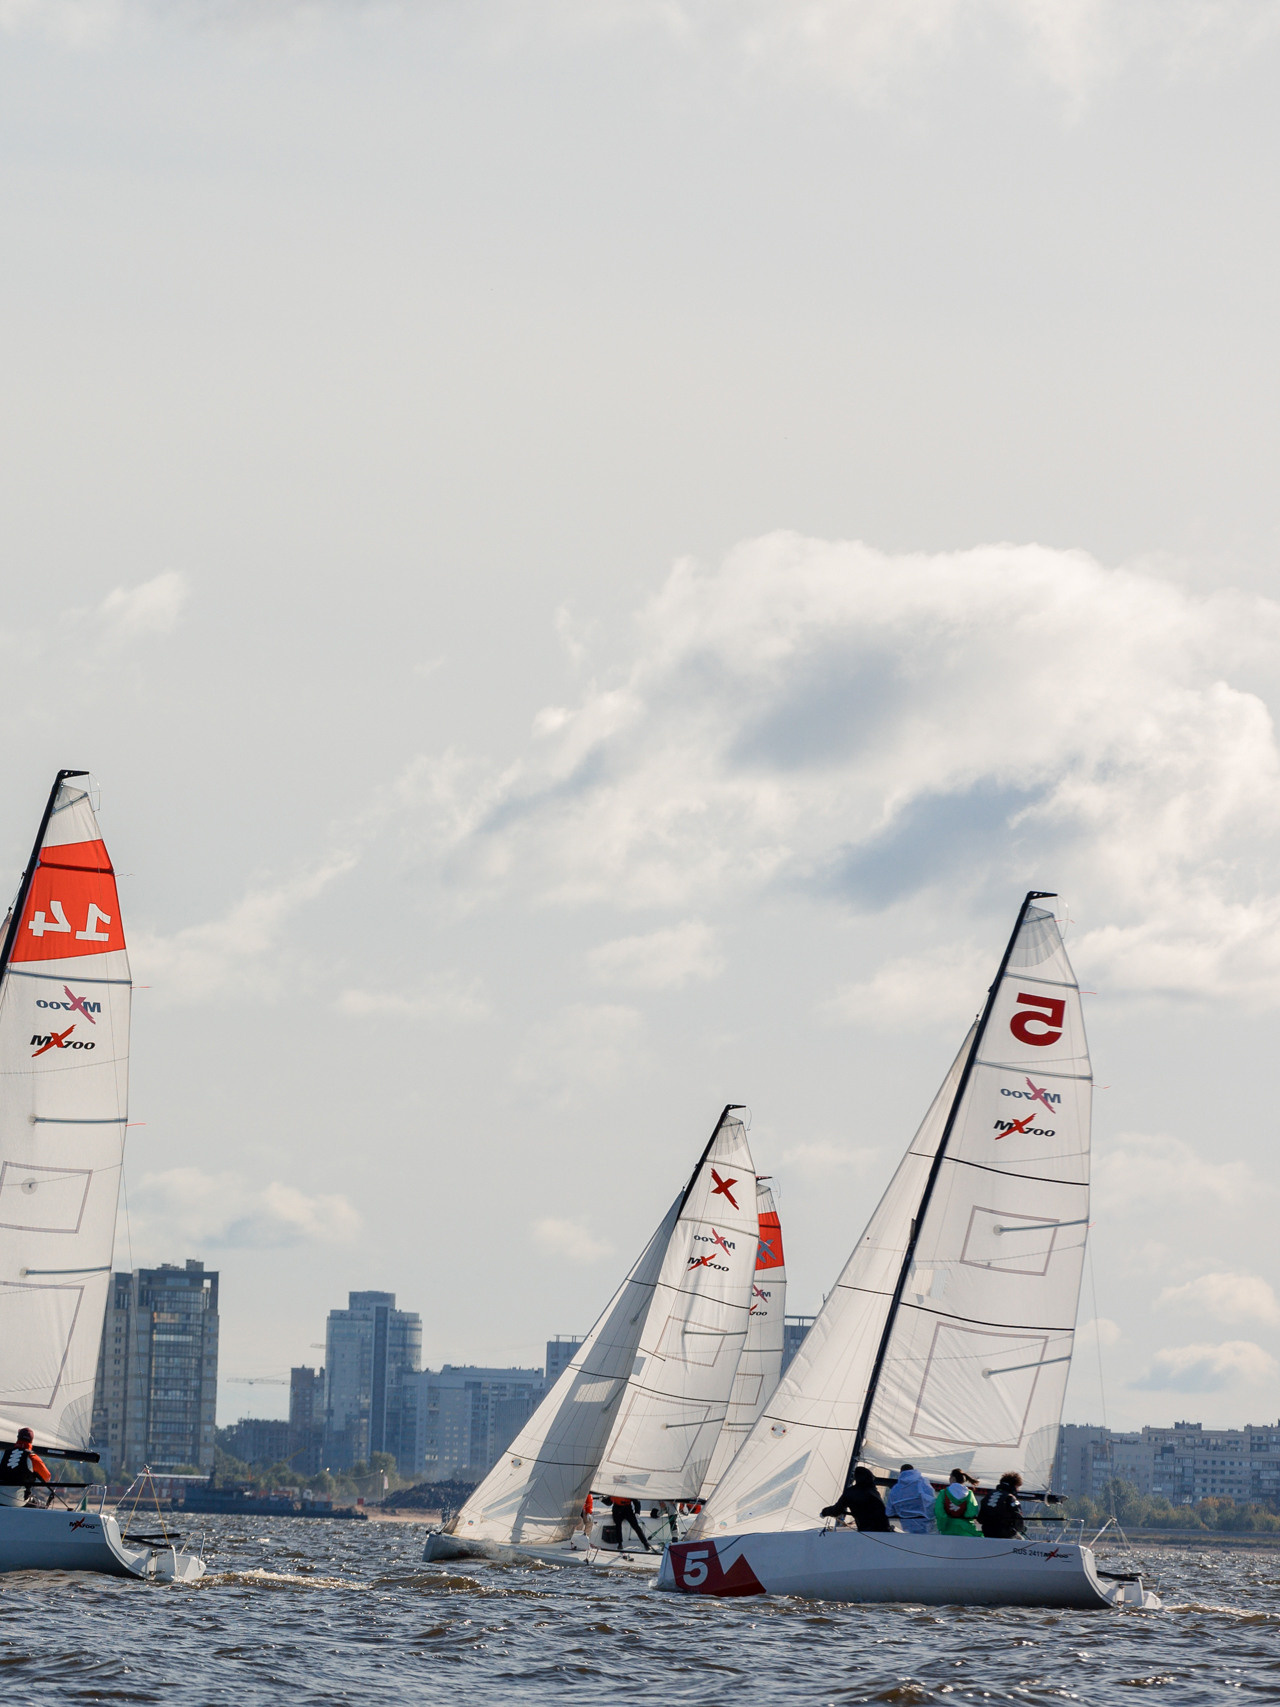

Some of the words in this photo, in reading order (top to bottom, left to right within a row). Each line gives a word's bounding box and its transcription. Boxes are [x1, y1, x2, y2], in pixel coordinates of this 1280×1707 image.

[30, 1024, 95, 1057] MX700
[993, 1113, 1056, 1140] MX700
[687, 1253, 730, 1272] MX700
[683, 1550, 709, 1587] 5
